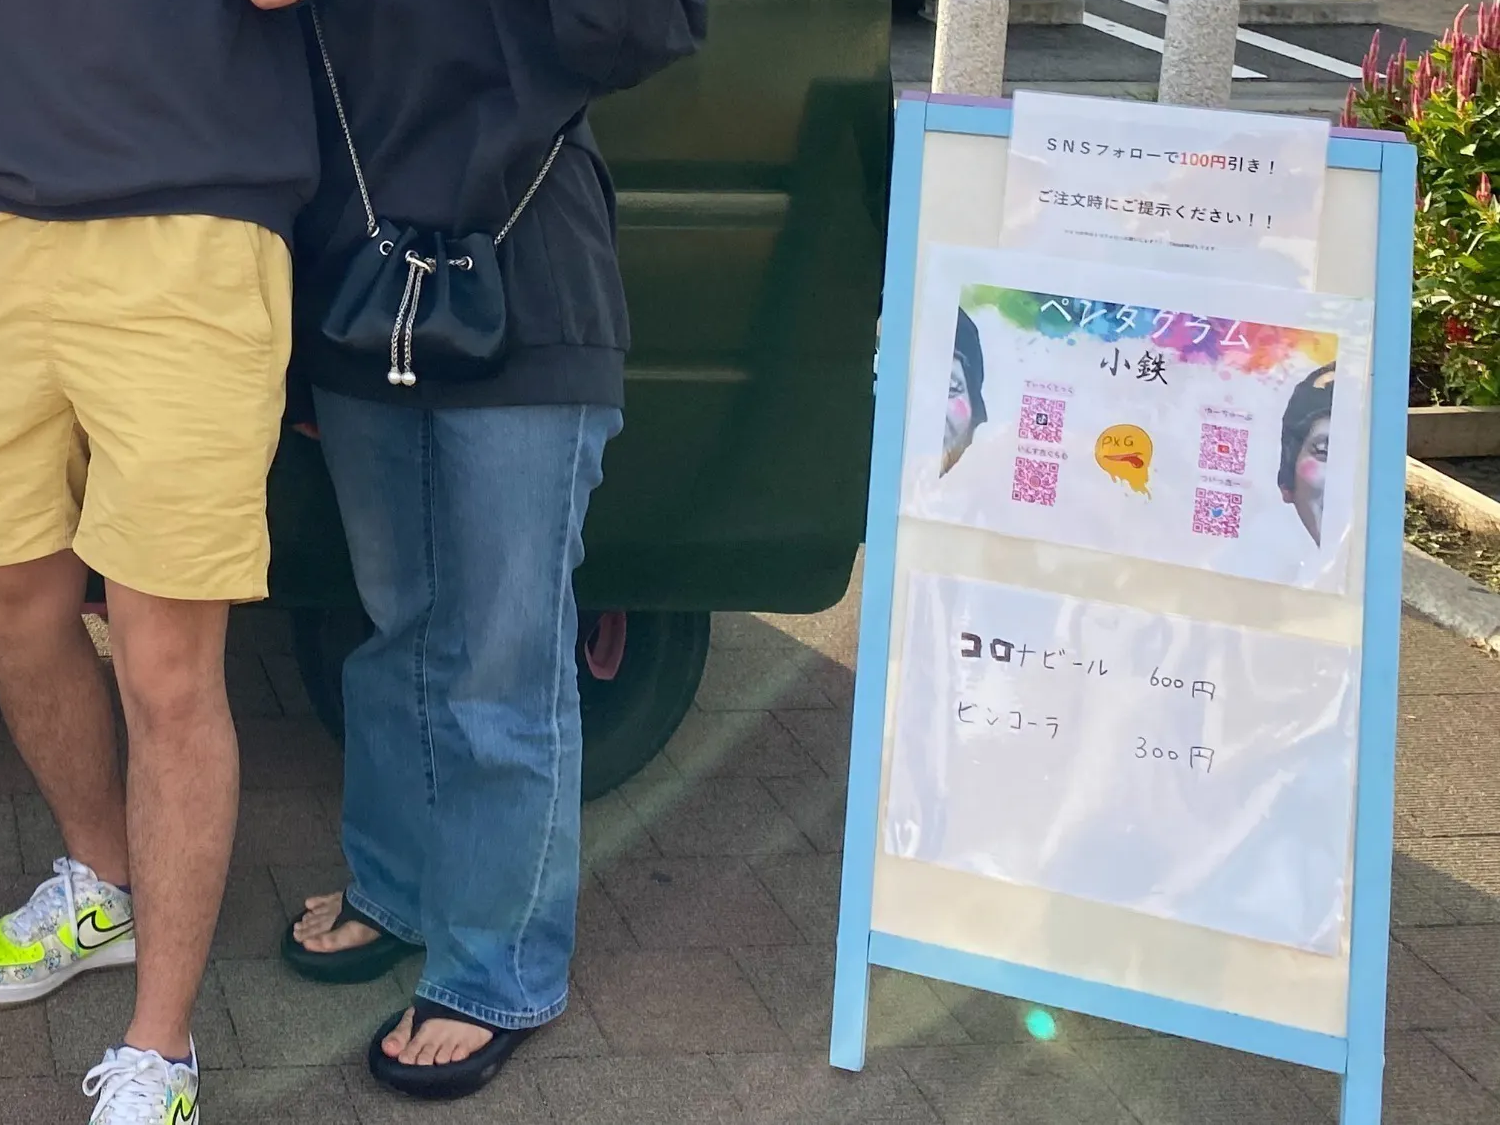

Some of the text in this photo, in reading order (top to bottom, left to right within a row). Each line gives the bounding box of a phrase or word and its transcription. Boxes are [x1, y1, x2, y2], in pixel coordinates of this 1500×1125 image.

[1040, 297, 1250, 348] ペンタグラム
[961, 632, 1215, 700] コロナビール 600円
[1134, 736, 1214, 773] 300円
